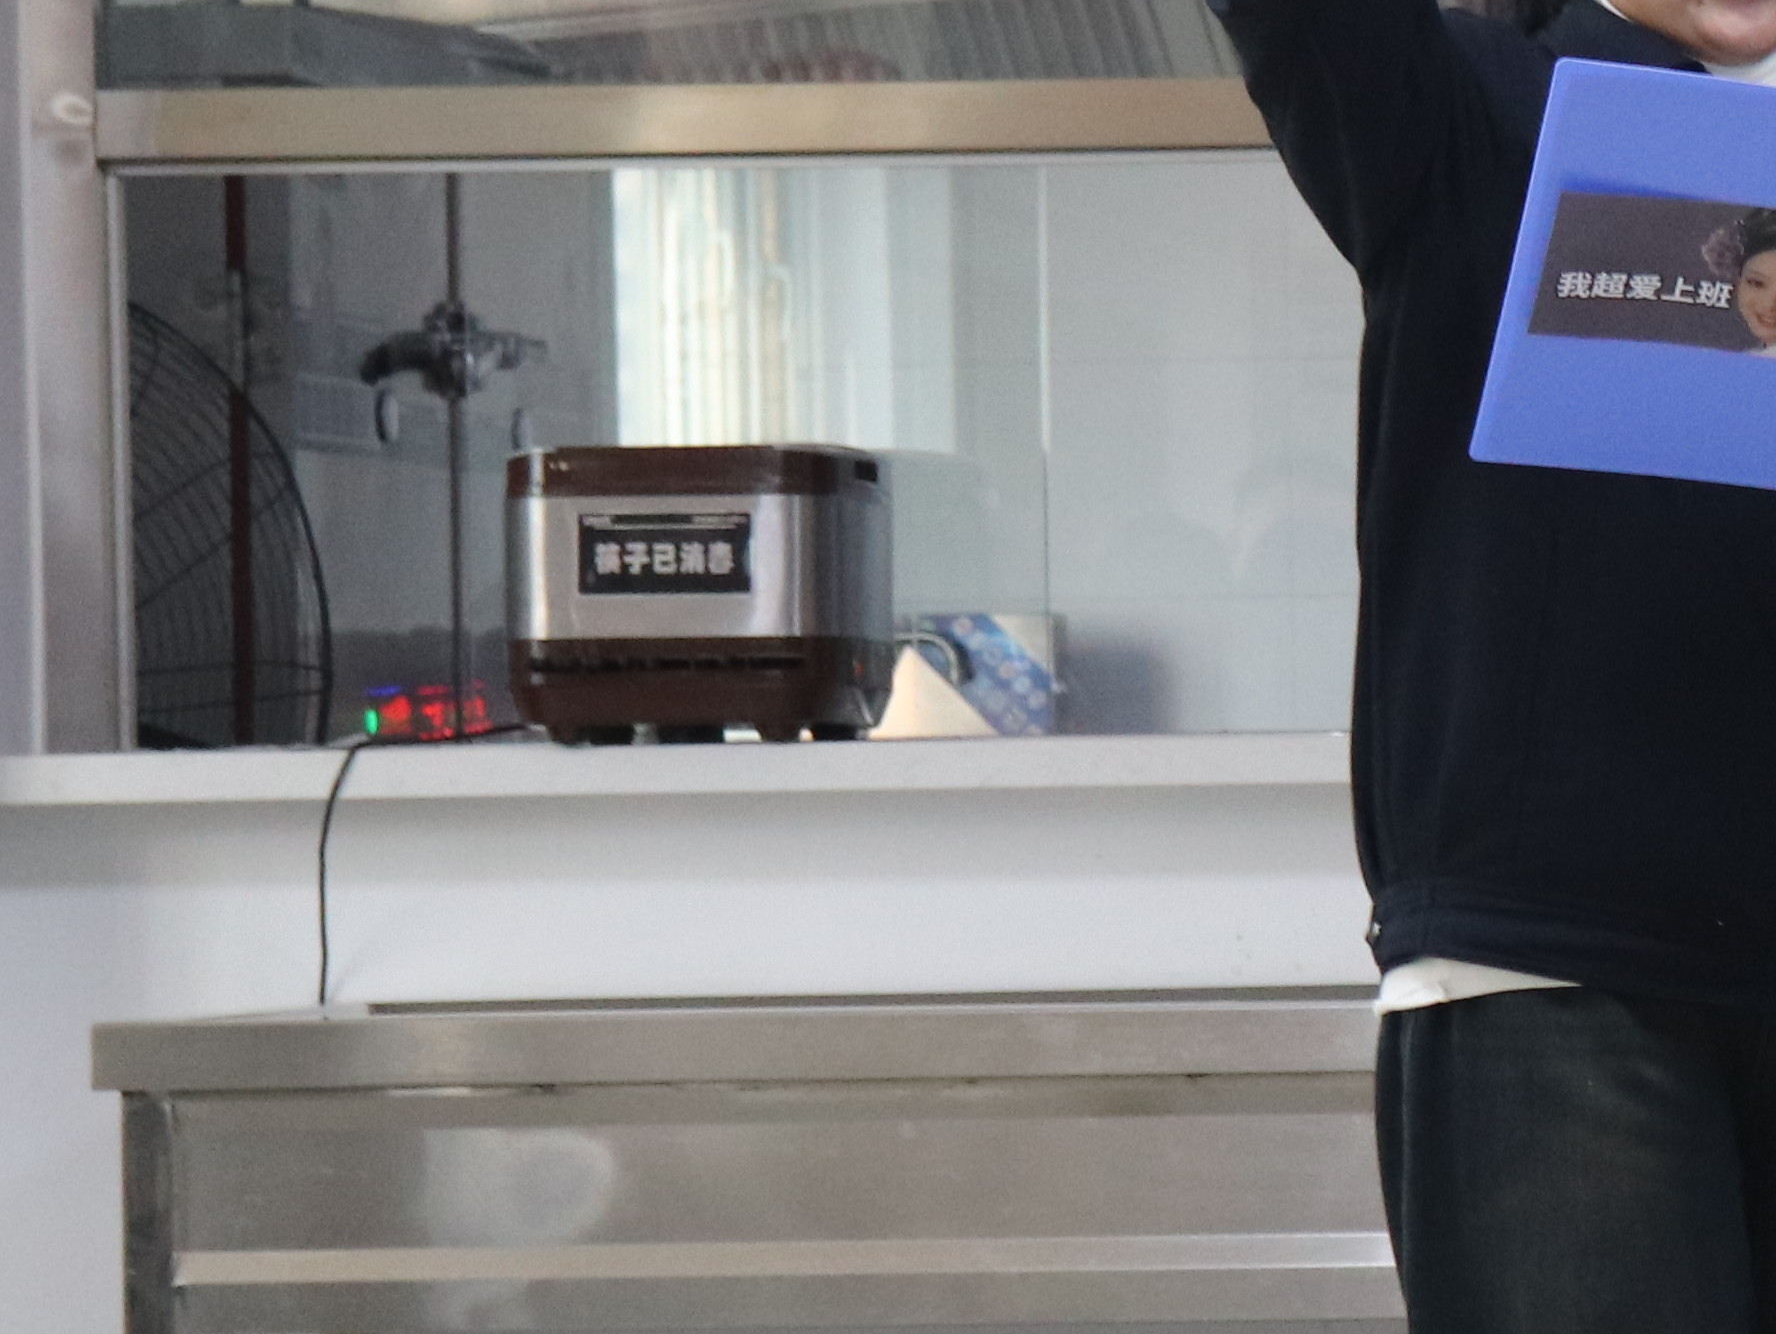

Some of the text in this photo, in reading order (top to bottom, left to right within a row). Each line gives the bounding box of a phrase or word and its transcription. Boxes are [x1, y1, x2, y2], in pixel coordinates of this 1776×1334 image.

[1557, 270, 1734, 309] 我超爱上班
[594, 540, 735, 576] 筷子已消毒
